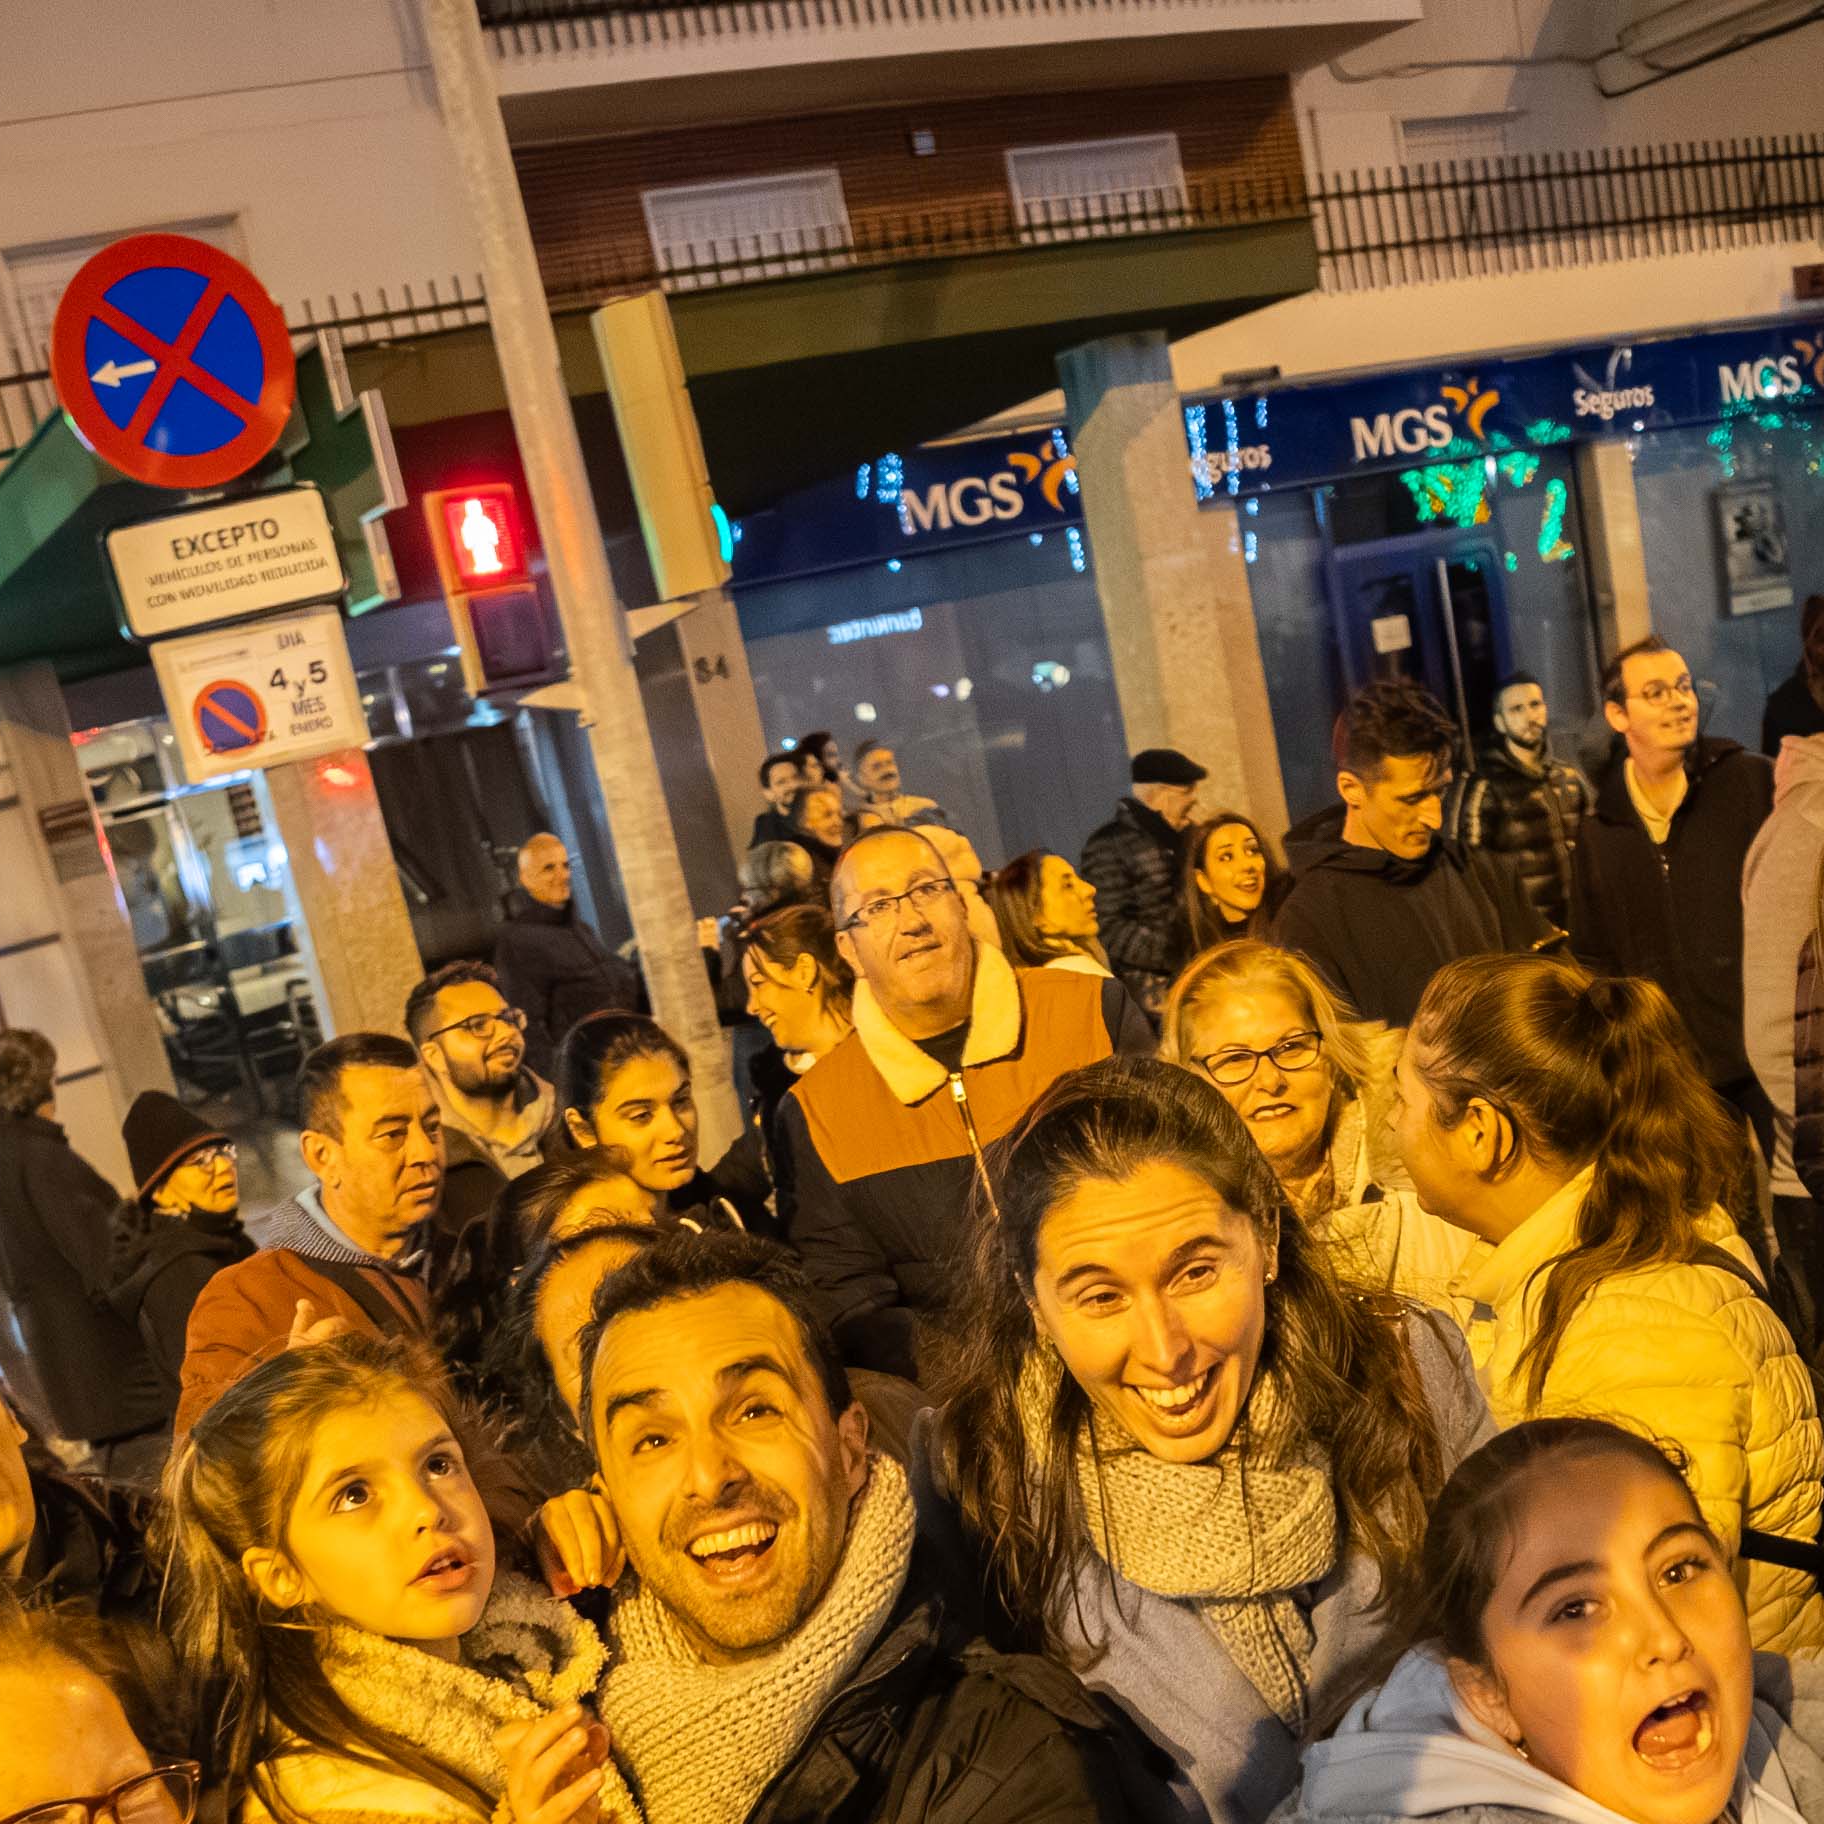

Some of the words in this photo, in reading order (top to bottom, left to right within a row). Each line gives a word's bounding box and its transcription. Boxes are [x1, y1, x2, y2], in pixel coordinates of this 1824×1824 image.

[1718, 355, 1802, 403] MGS
[1573, 384, 1655, 420] Seguros
[1350, 404, 1453, 460] MGS
[899, 471, 1024, 535] MGS
[170, 517, 280, 560] EXCEPTO
[226, 556, 243, 570] DE
[247, 537, 318, 564] PERSONAS
[147, 592, 178, 609] CON
[180, 573, 258, 601] MOVILIDAD
[261, 556, 328, 583] REDUCIDA
[269, 667, 289, 691] 4
[293, 678, 307, 698] y
[308, 660, 328, 684] 5
[291, 695, 327, 717] MES
[289, 716, 334, 737] ENERO
